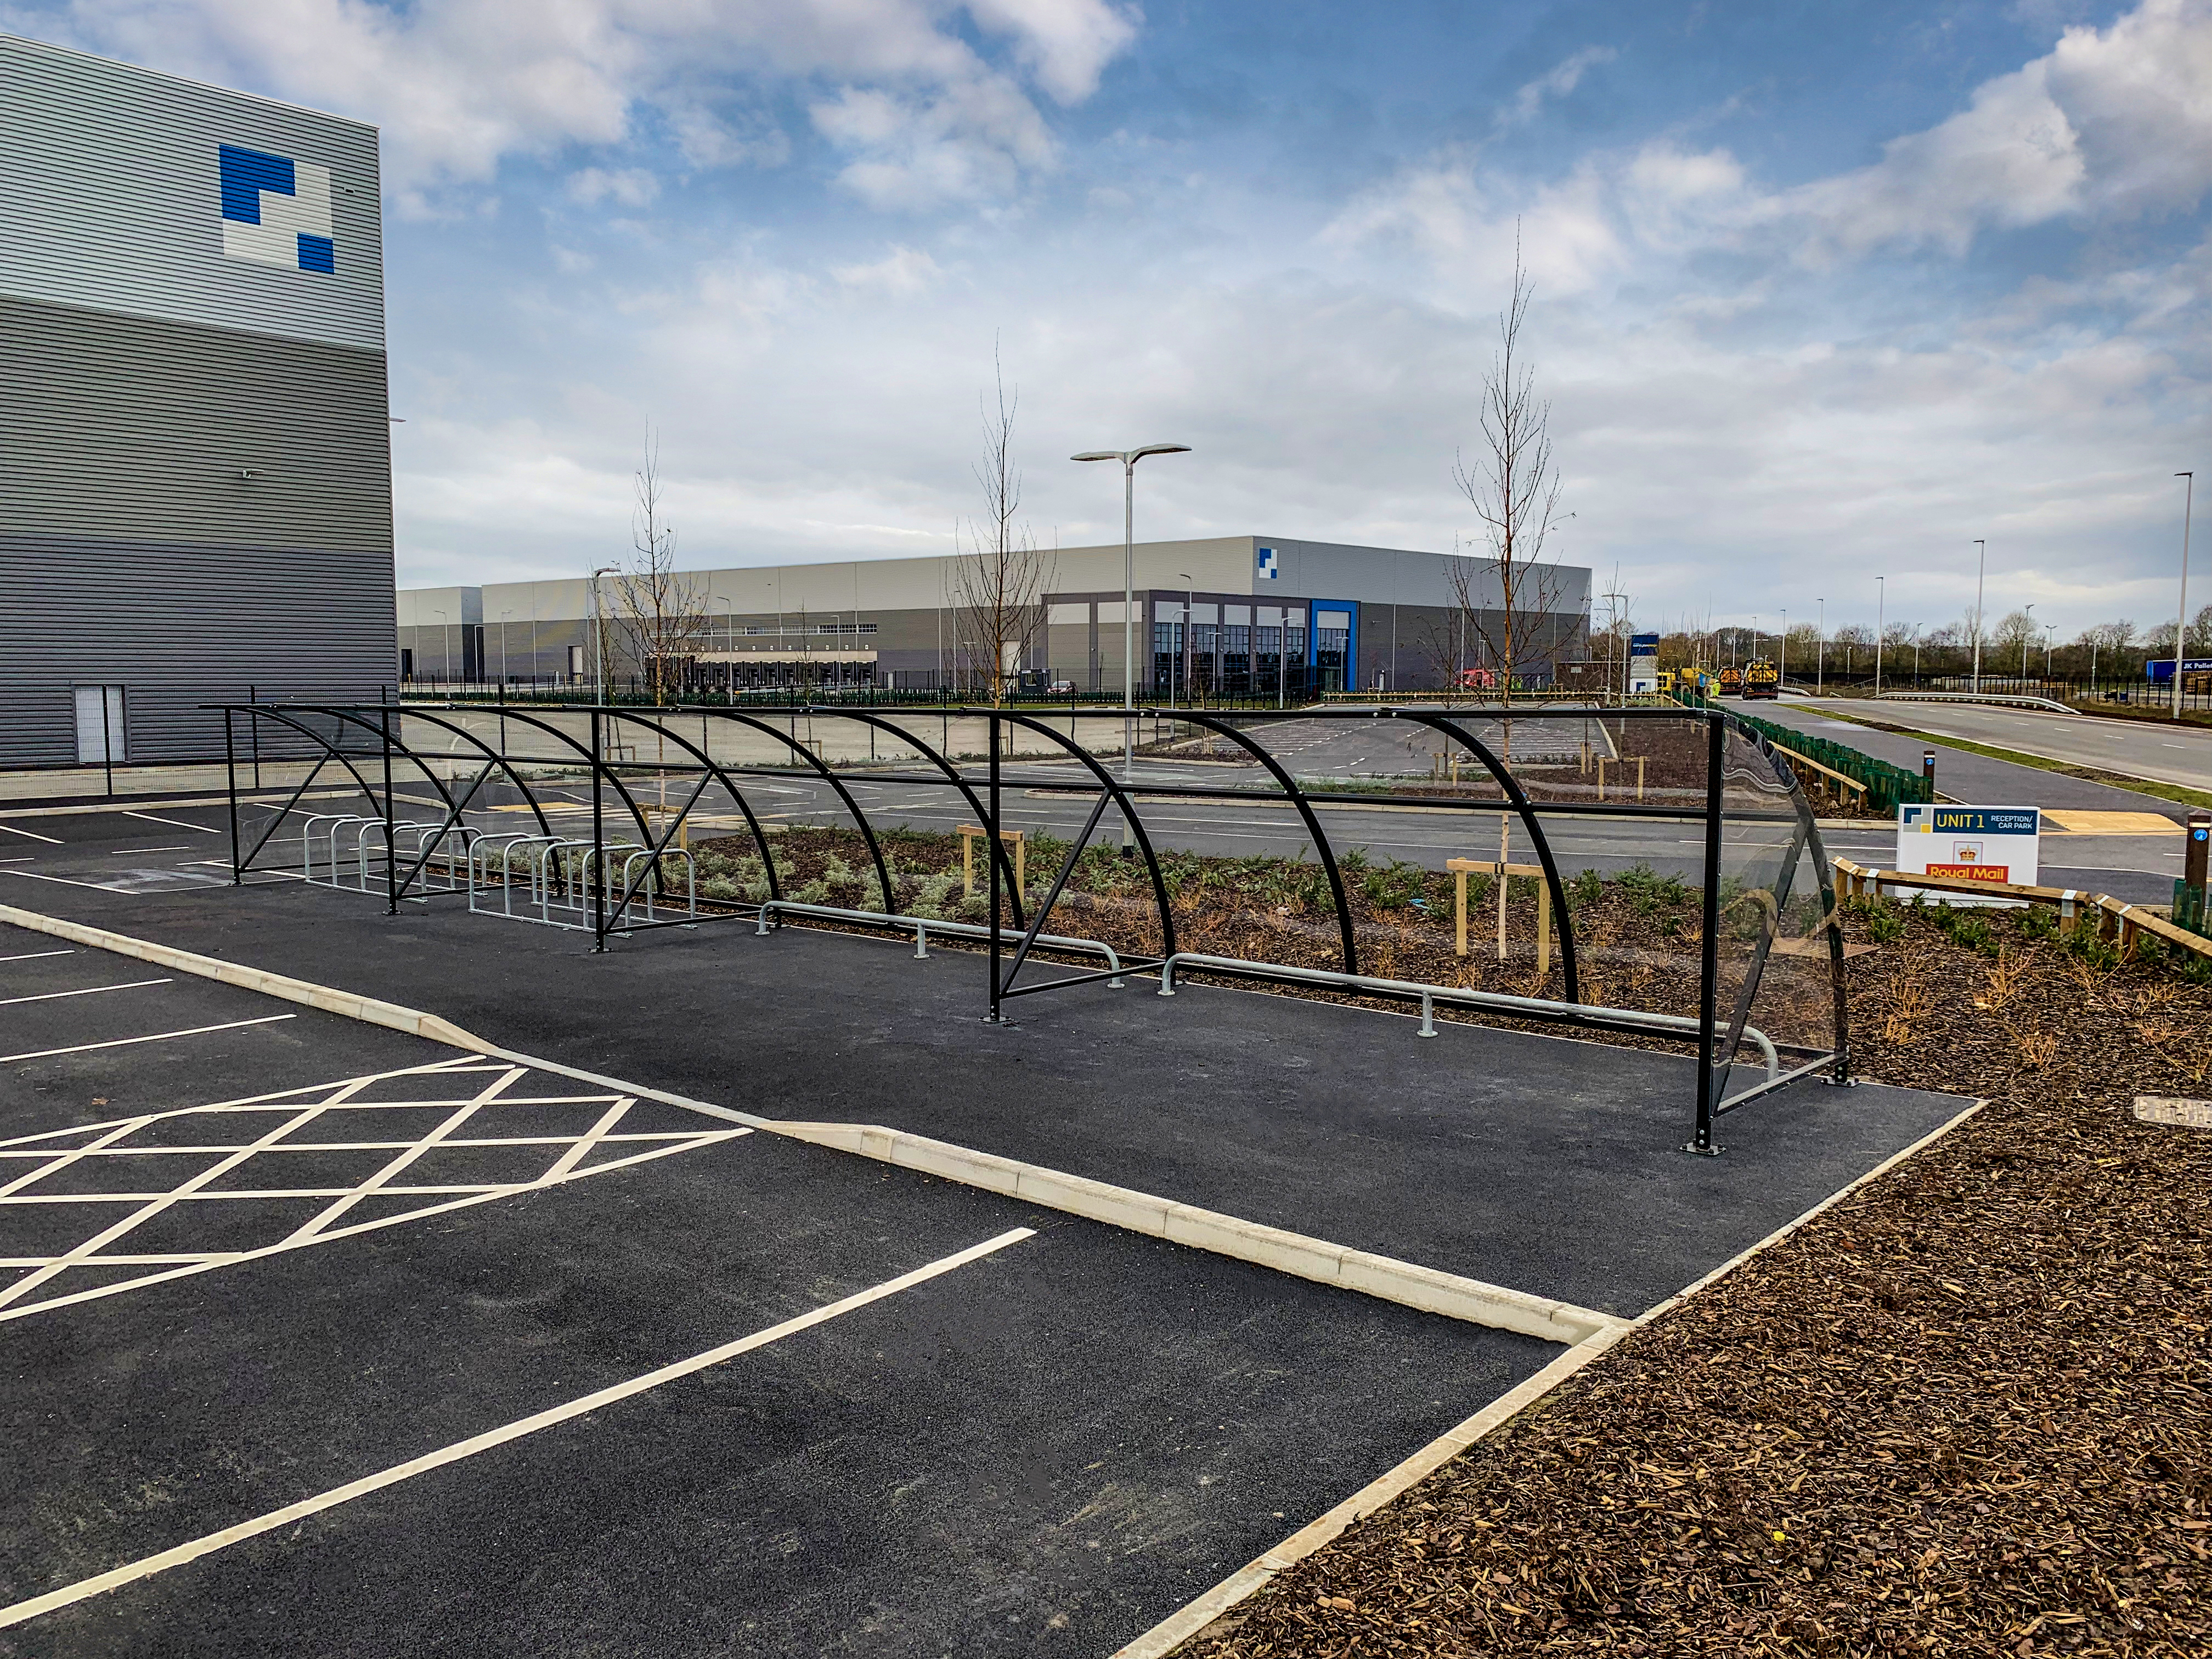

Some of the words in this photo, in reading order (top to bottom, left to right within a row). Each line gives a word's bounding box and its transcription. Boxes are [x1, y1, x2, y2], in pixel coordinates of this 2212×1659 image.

[1937, 814, 1974, 828] UNIT
[1977, 815, 1984, 828] 1
[1931, 866, 1970, 878] Royal
[1973, 867, 2004, 879] Mail
